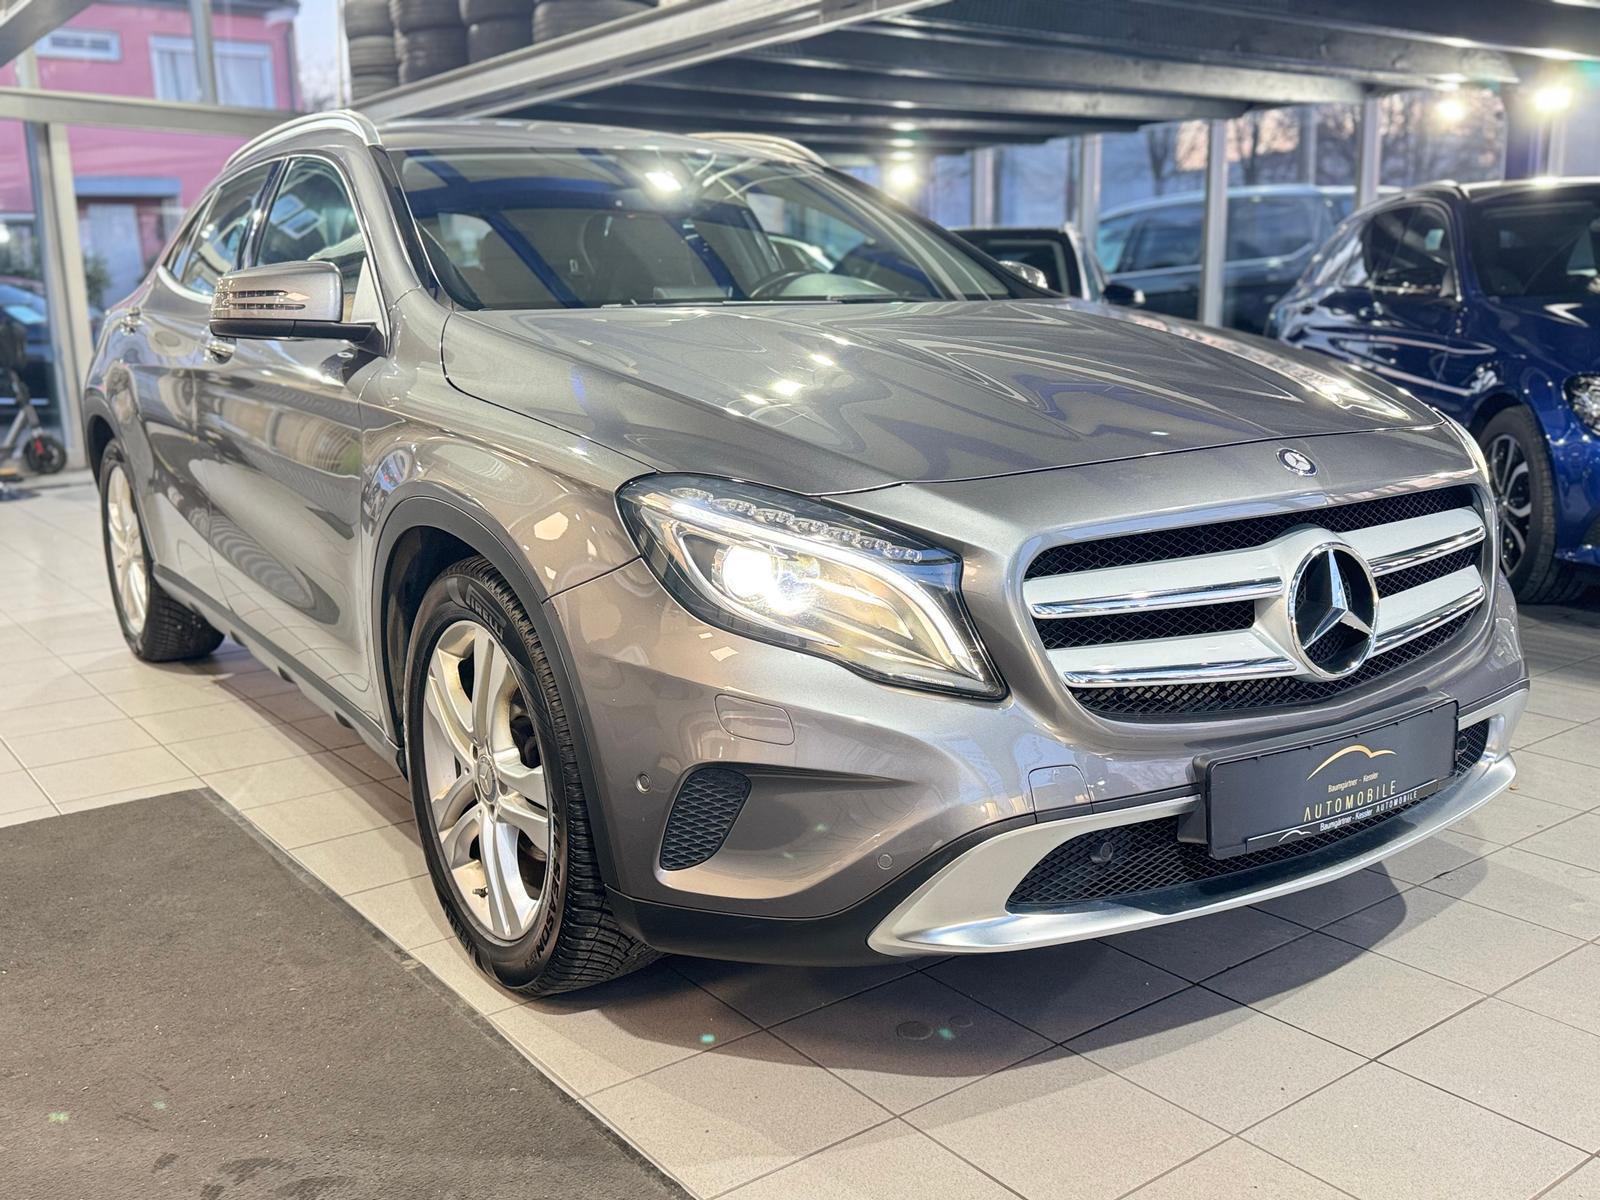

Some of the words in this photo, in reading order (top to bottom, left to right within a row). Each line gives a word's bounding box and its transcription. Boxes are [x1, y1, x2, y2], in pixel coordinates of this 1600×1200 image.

[1303, 780, 1397, 822] AUTOMOBILE
[1376, 790, 1418, 813] AUTOMOBILE
[536, 857, 561, 958] SEASON
